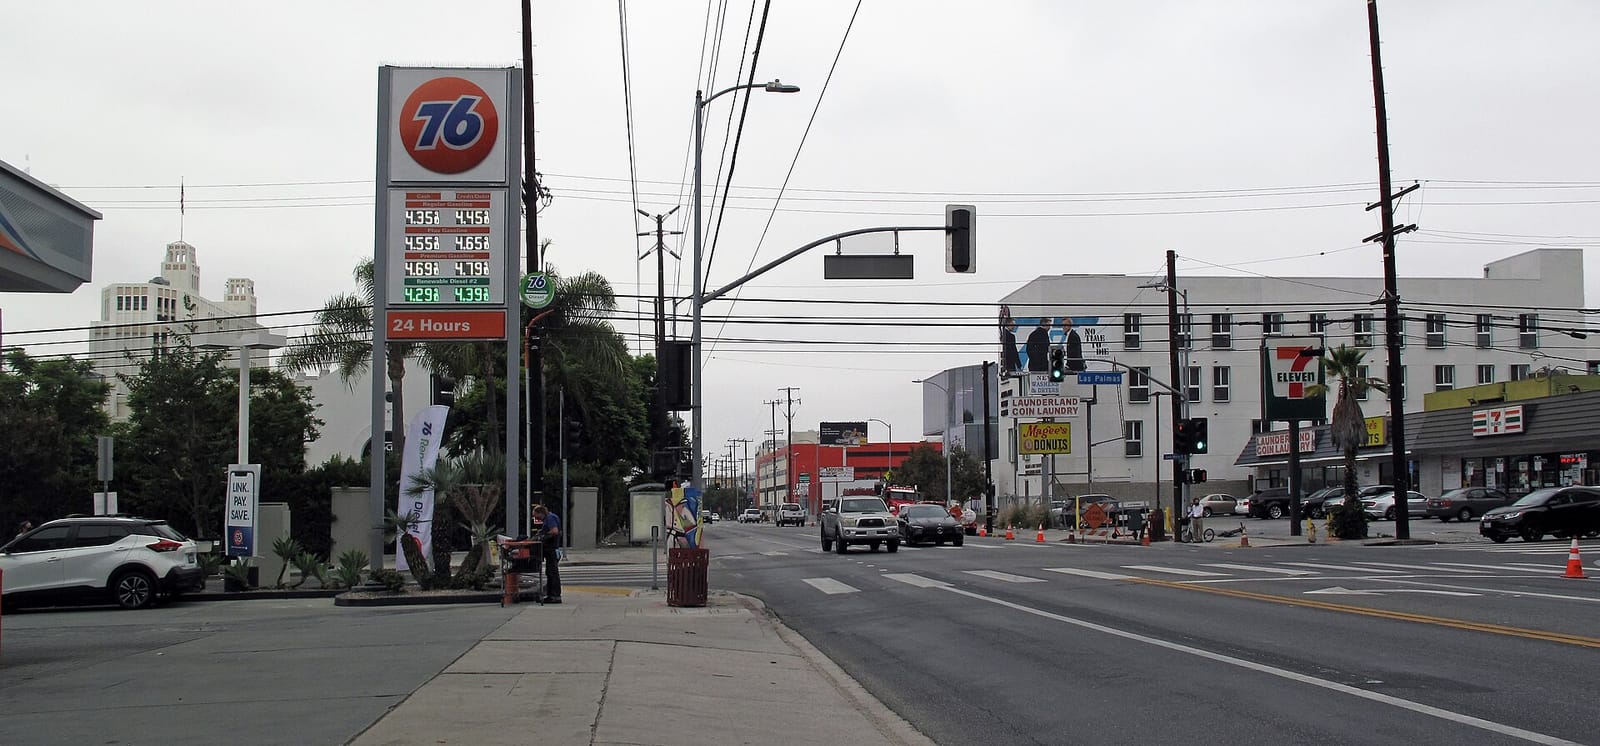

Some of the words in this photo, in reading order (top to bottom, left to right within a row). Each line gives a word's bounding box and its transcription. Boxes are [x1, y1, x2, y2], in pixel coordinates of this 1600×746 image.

[413, 95, 485, 150] 76
[528, 275, 546, 288] 76
[392, 318, 415, 332] 24
[420, 318, 472, 332] Hours
[1084, 328, 1096, 336] NO
[1096, 348, 1110, 356] DIE
[1277, 345, 1313, 399] 7
[1096, 374, 1121, 383] Palmas
[1013, 398, 1078, 407] LAUNDERLAND
[1013, 407, 1035, 416] COIN
[1037, 407, 1079, 415] LAUNDRY
[422, 421, 432, 435] 76
[1024, 425, 1068, 439] Magee's
[1034, 439, 1068, 450] DONUTS
[1257, 433, 1311, 446] LAUNDERND
[1257, 446, 1274, 454] COIN
[1275, 441, 1311, 452] LAURY
[233, 483, 249, 492] LINK.
[234, 497, 247, 506] PAY.
[231, 510, 249, 520] SAVE.
